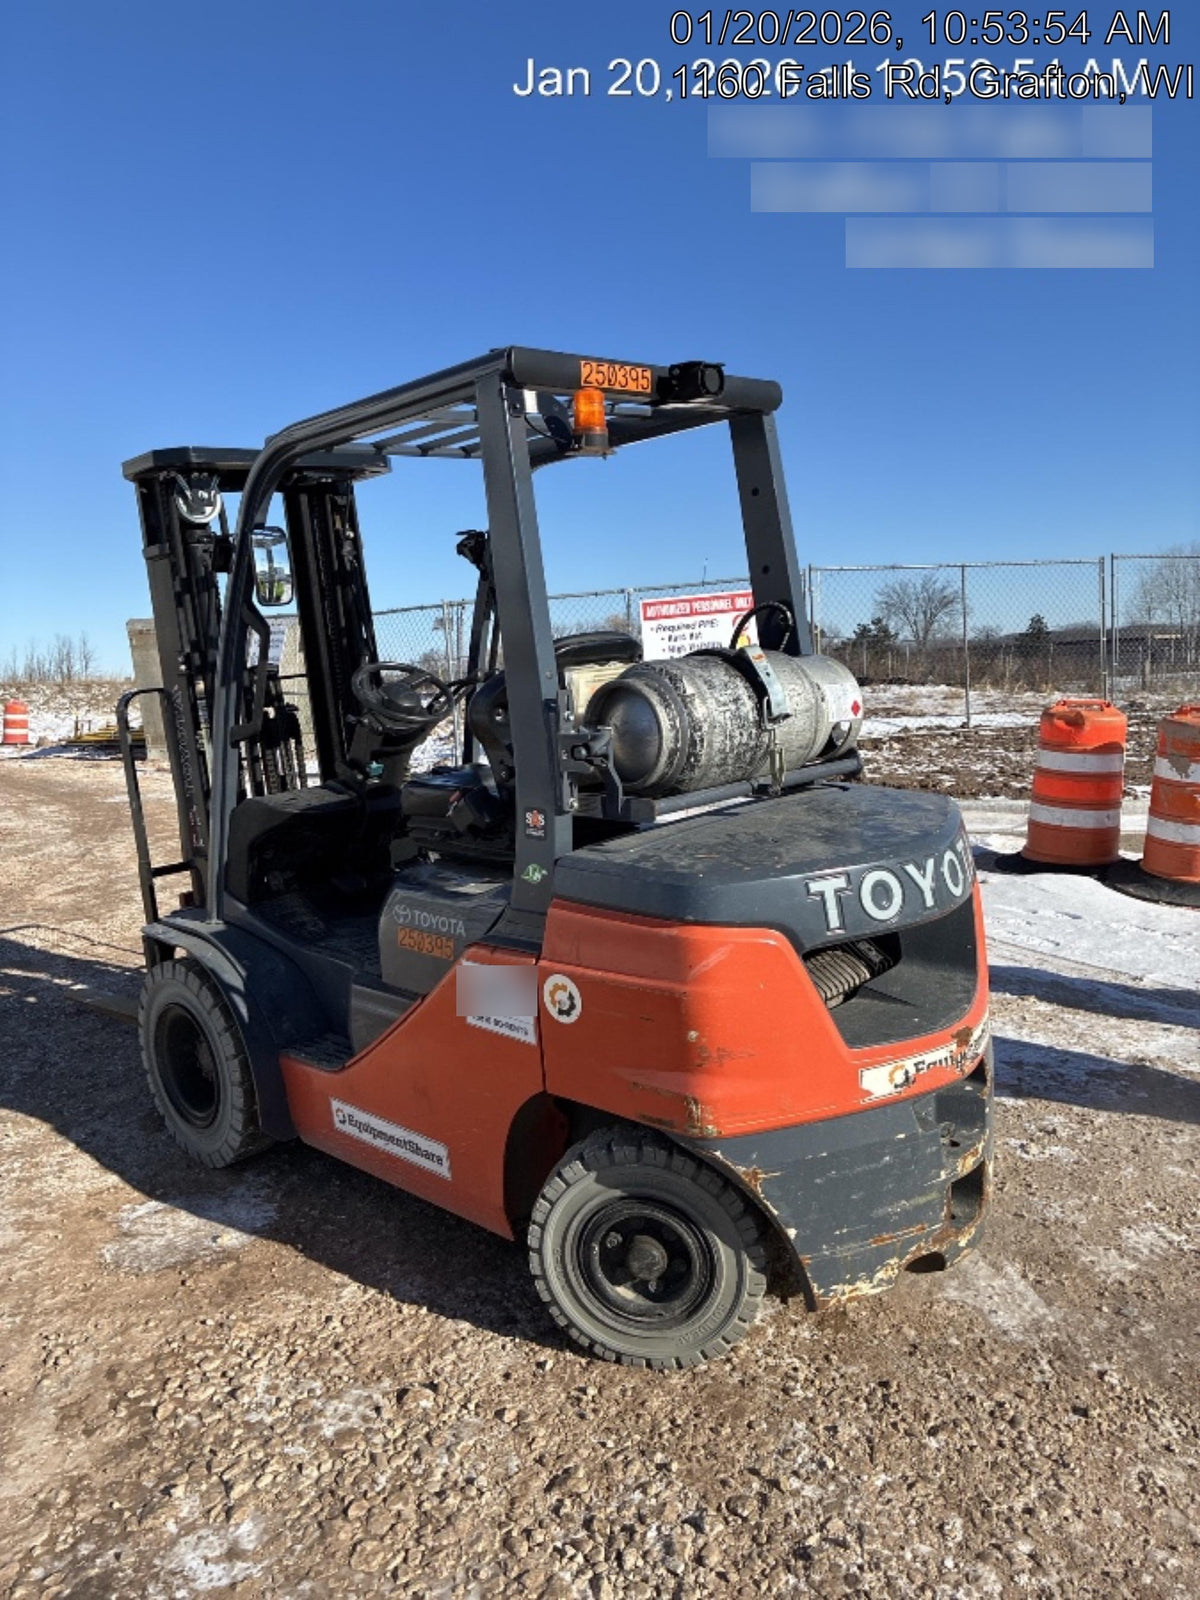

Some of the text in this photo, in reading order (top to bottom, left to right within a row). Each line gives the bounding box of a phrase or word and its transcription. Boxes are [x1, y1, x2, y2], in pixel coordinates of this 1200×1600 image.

[582, 361, 650, 391] 250395
[413, 909, 467, 938] TOYOTA
[399, 927, 453, 959] 250395
[346, 1113, 443, 1167] EquipmentShare
